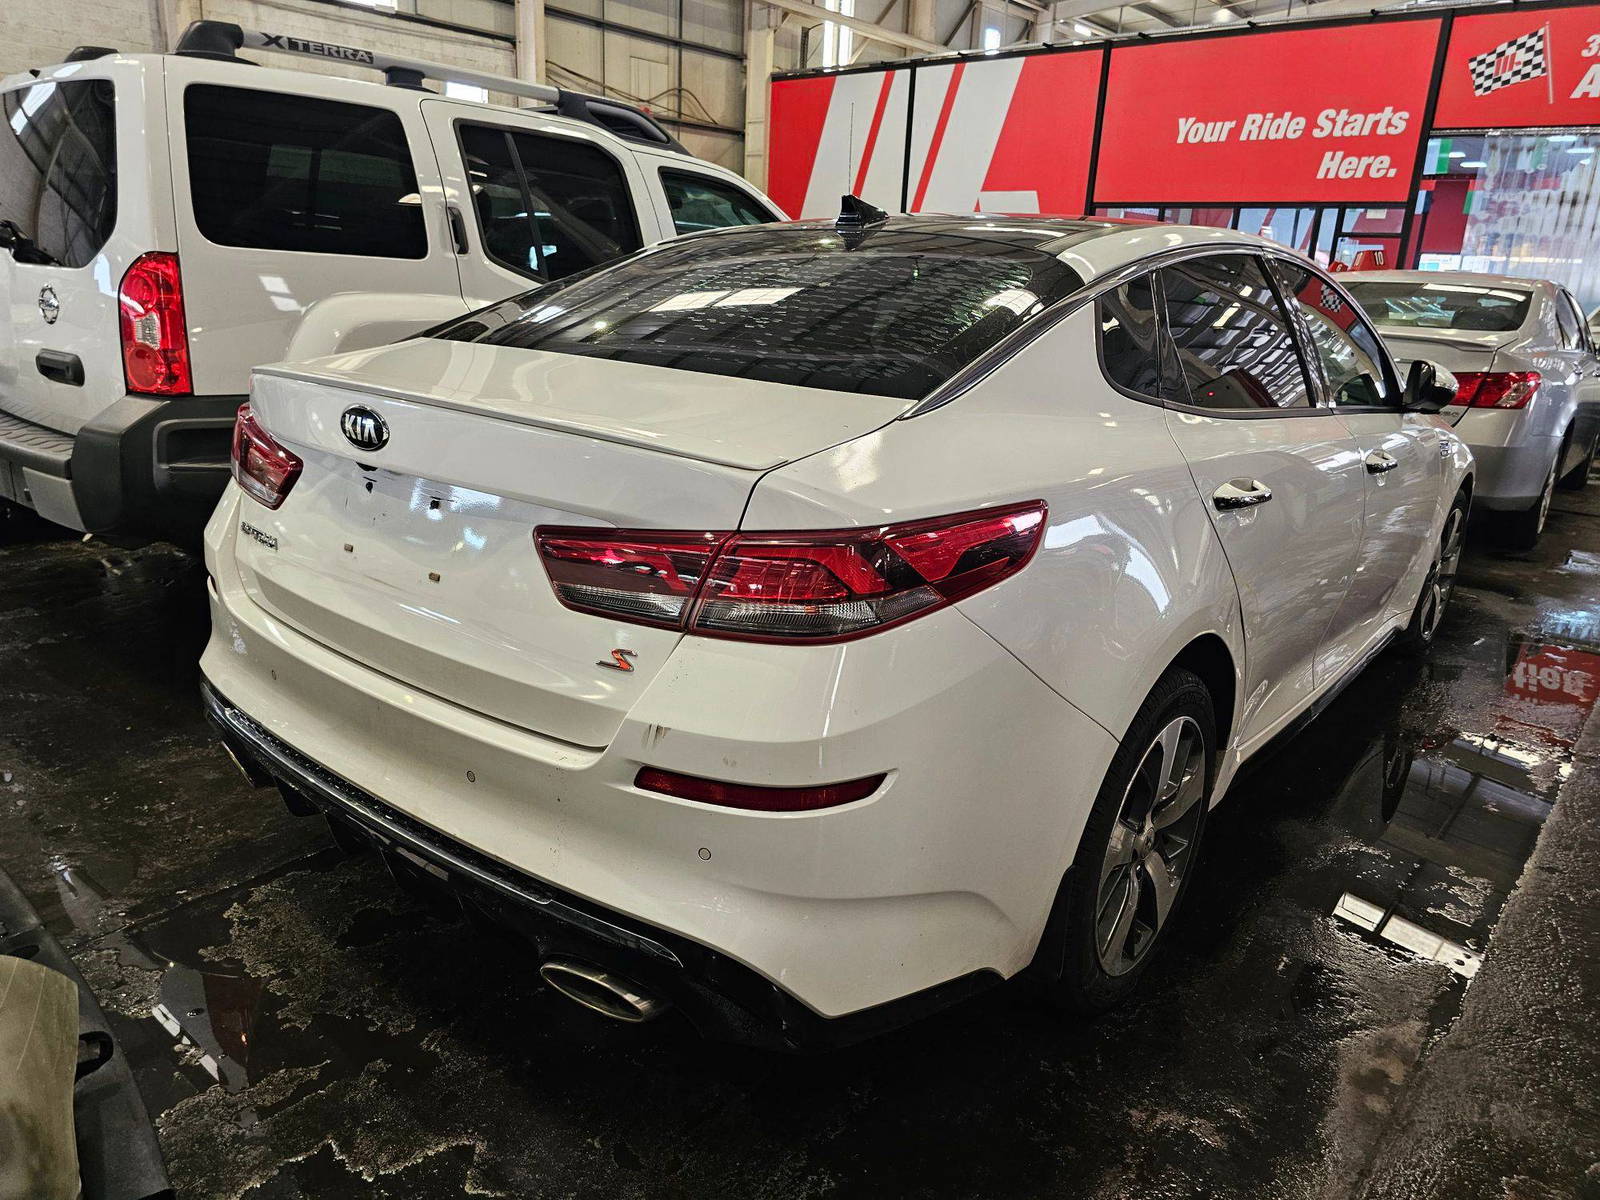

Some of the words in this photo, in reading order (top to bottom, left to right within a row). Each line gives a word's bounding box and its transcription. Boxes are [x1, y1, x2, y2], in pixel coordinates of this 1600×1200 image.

[260, 32, 374, 64] XTERRA
[1176, 117, 1236, 144] Your
[1239, 111, 1306, 141] Ride
[1312, 106, 1410, 138] Starts
[1316, 151, 1398, 179] Here.
[345, 413, 379, 444] KIA
[595, 649, 638, 672] S
